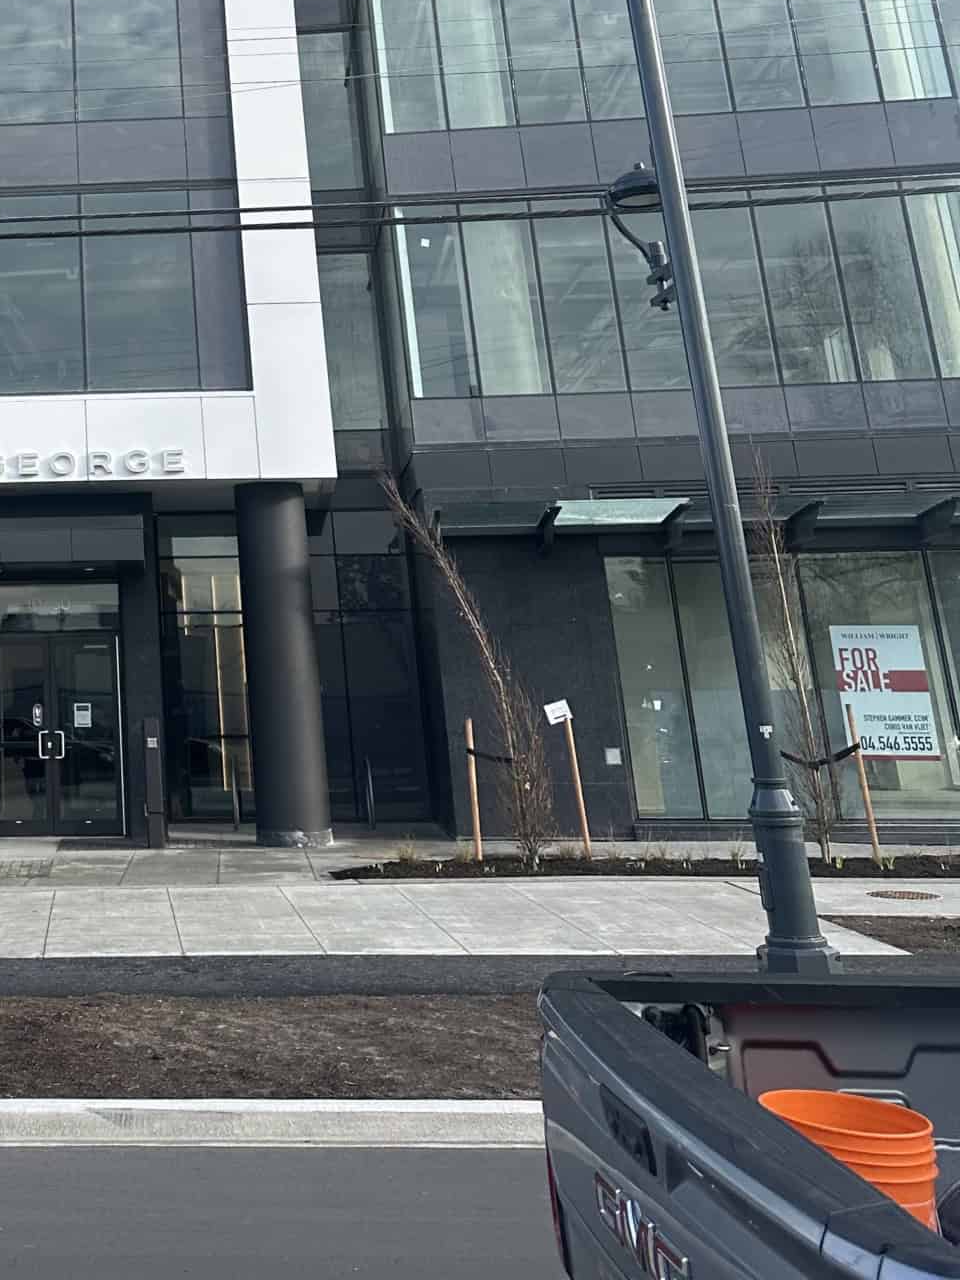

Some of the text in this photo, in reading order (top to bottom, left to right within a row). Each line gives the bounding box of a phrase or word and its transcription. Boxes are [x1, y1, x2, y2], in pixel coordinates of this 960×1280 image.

[838, 647, 880, 671] FOR
[843, 670, 892, 691] SALE
[860, 736, 933, 751] 04.546.5555
